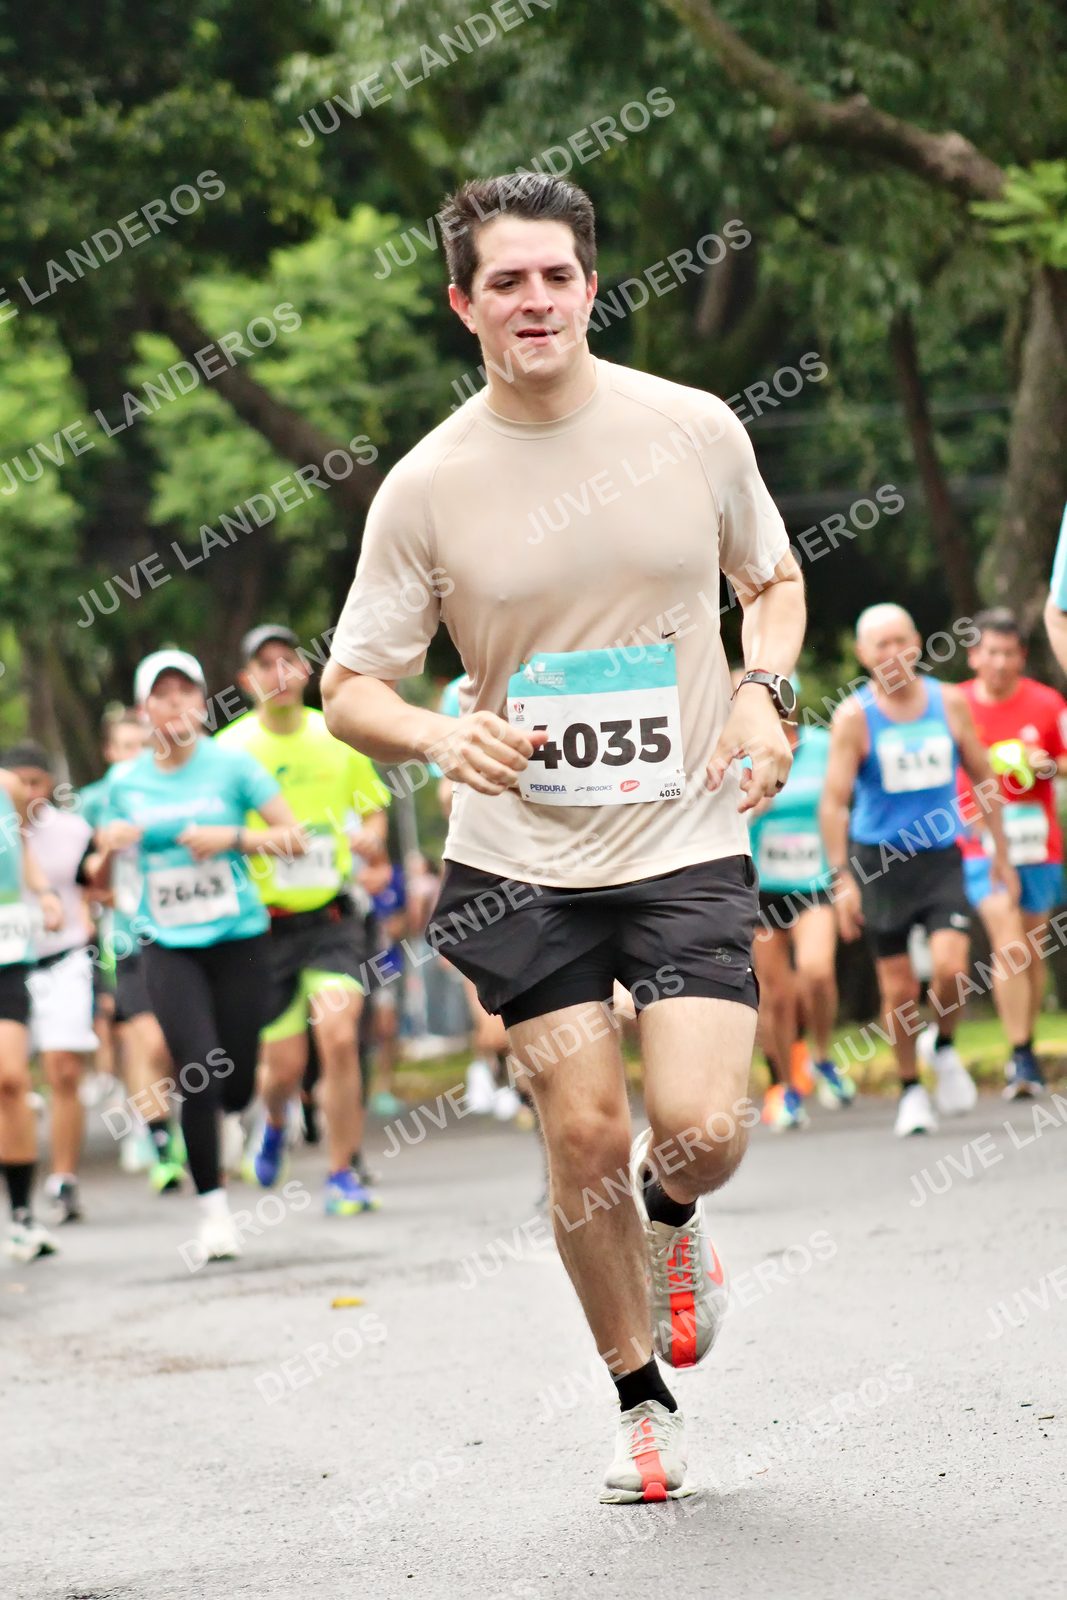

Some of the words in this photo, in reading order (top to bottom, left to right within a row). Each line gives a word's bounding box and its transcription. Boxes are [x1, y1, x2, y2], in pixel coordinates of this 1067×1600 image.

[527, 716, 672, 770] 4035
[530, 783, 567, 793] PERDURA
[586, 784, 613, 792] BROOKS
[659, 788, 681, 798] 4035
